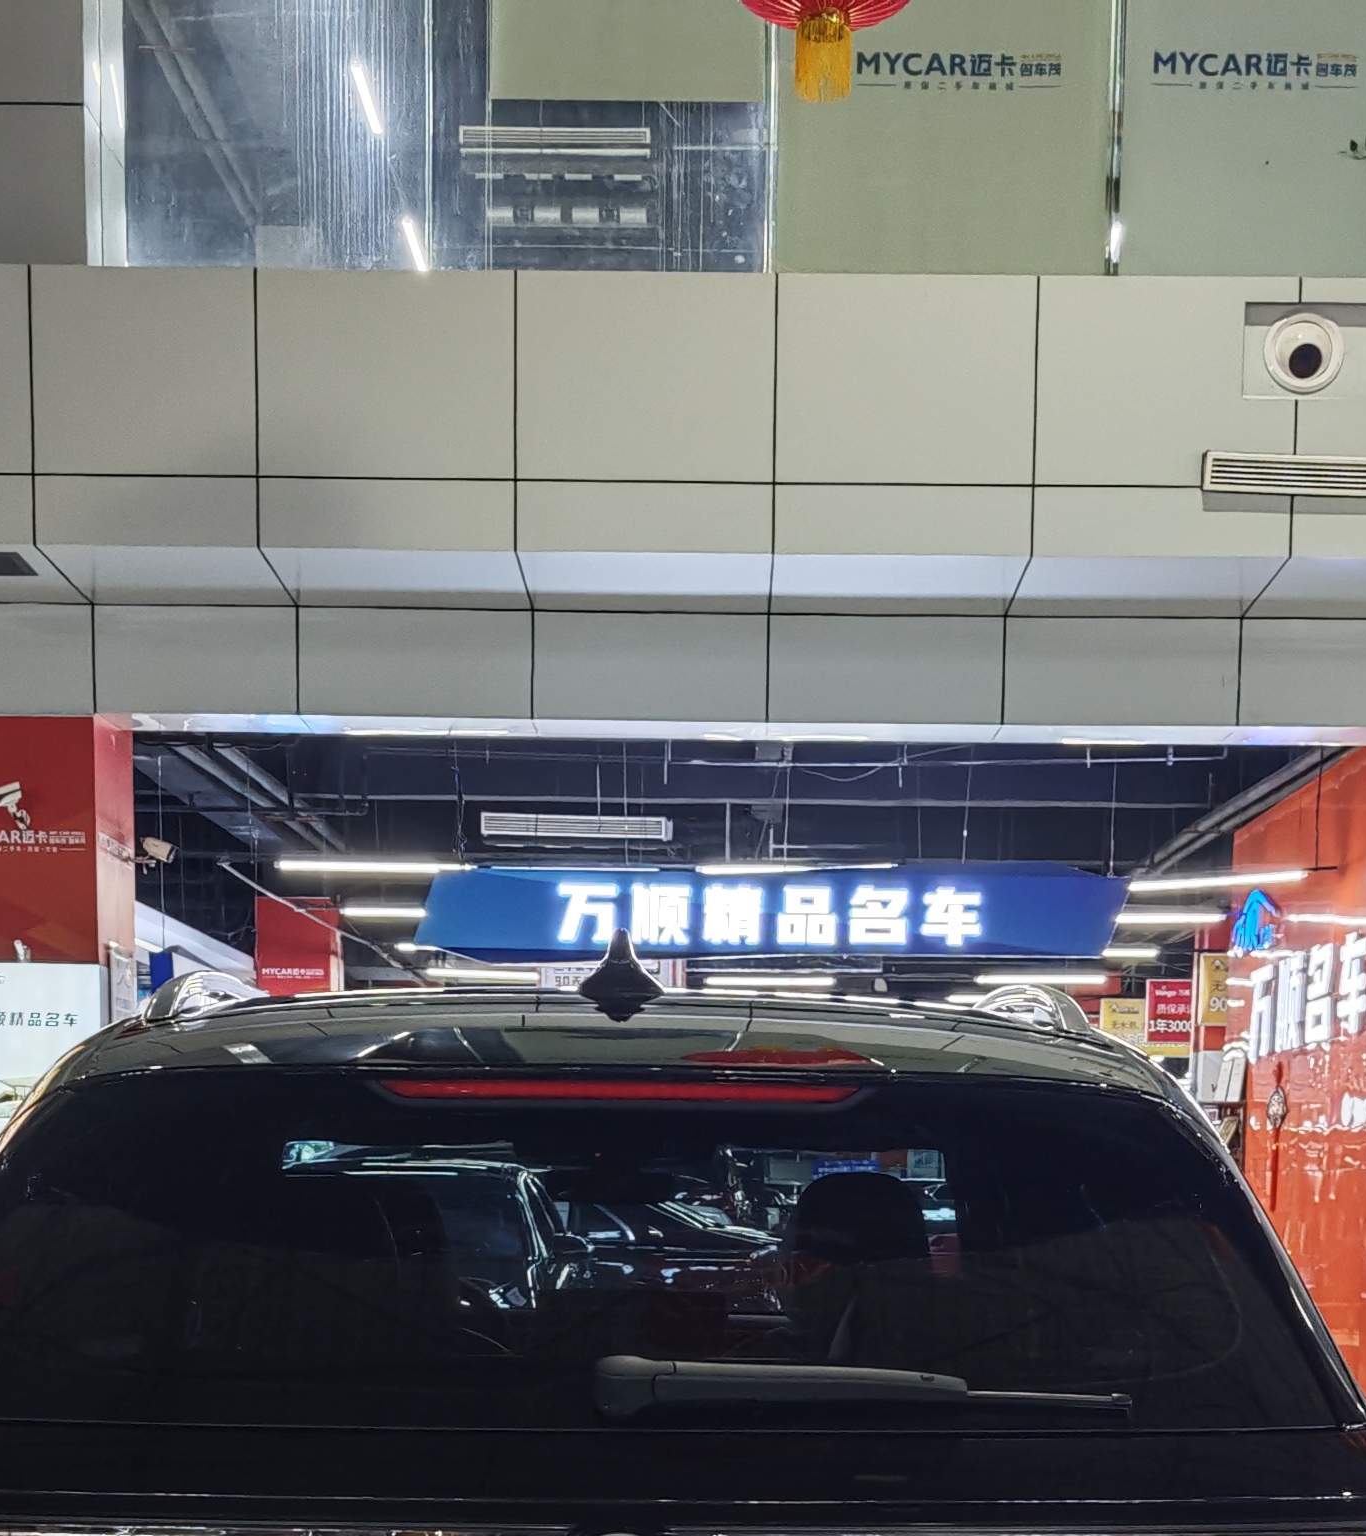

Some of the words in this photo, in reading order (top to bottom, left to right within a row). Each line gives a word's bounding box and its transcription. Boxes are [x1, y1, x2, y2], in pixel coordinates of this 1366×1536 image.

[557, 882, 981, 946] 万顺精品名车
